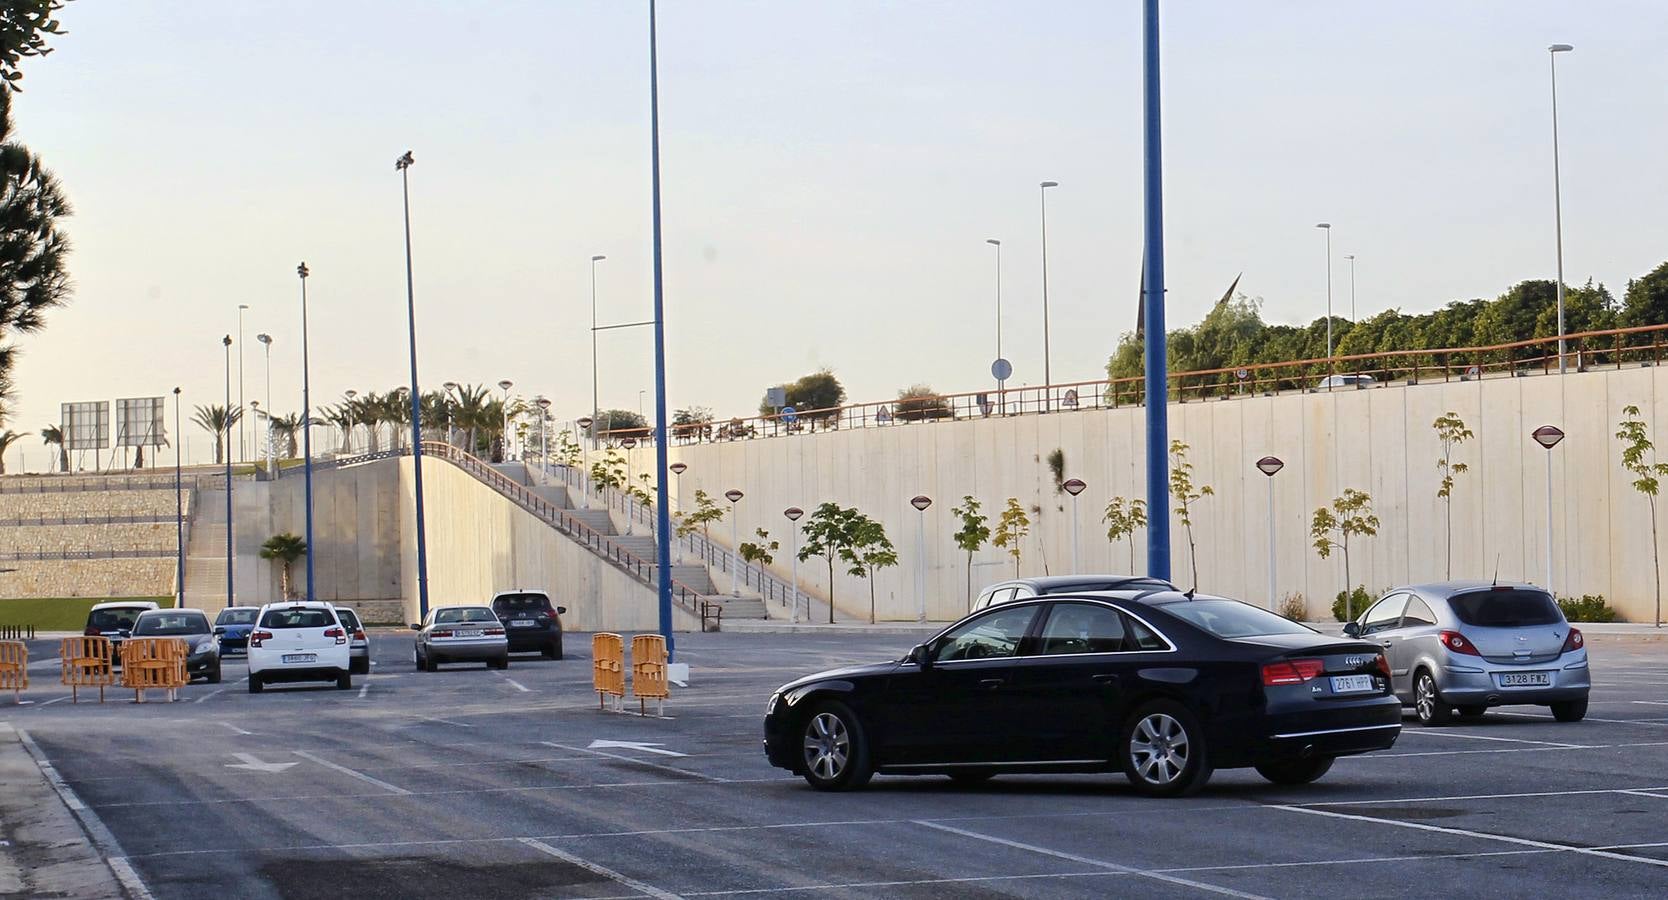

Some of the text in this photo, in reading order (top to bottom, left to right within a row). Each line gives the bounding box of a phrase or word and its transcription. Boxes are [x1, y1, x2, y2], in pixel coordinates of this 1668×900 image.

[1335, 678, 1355, 690] 2761
[1505, 674, 1548, 684] 3128 FWZ
